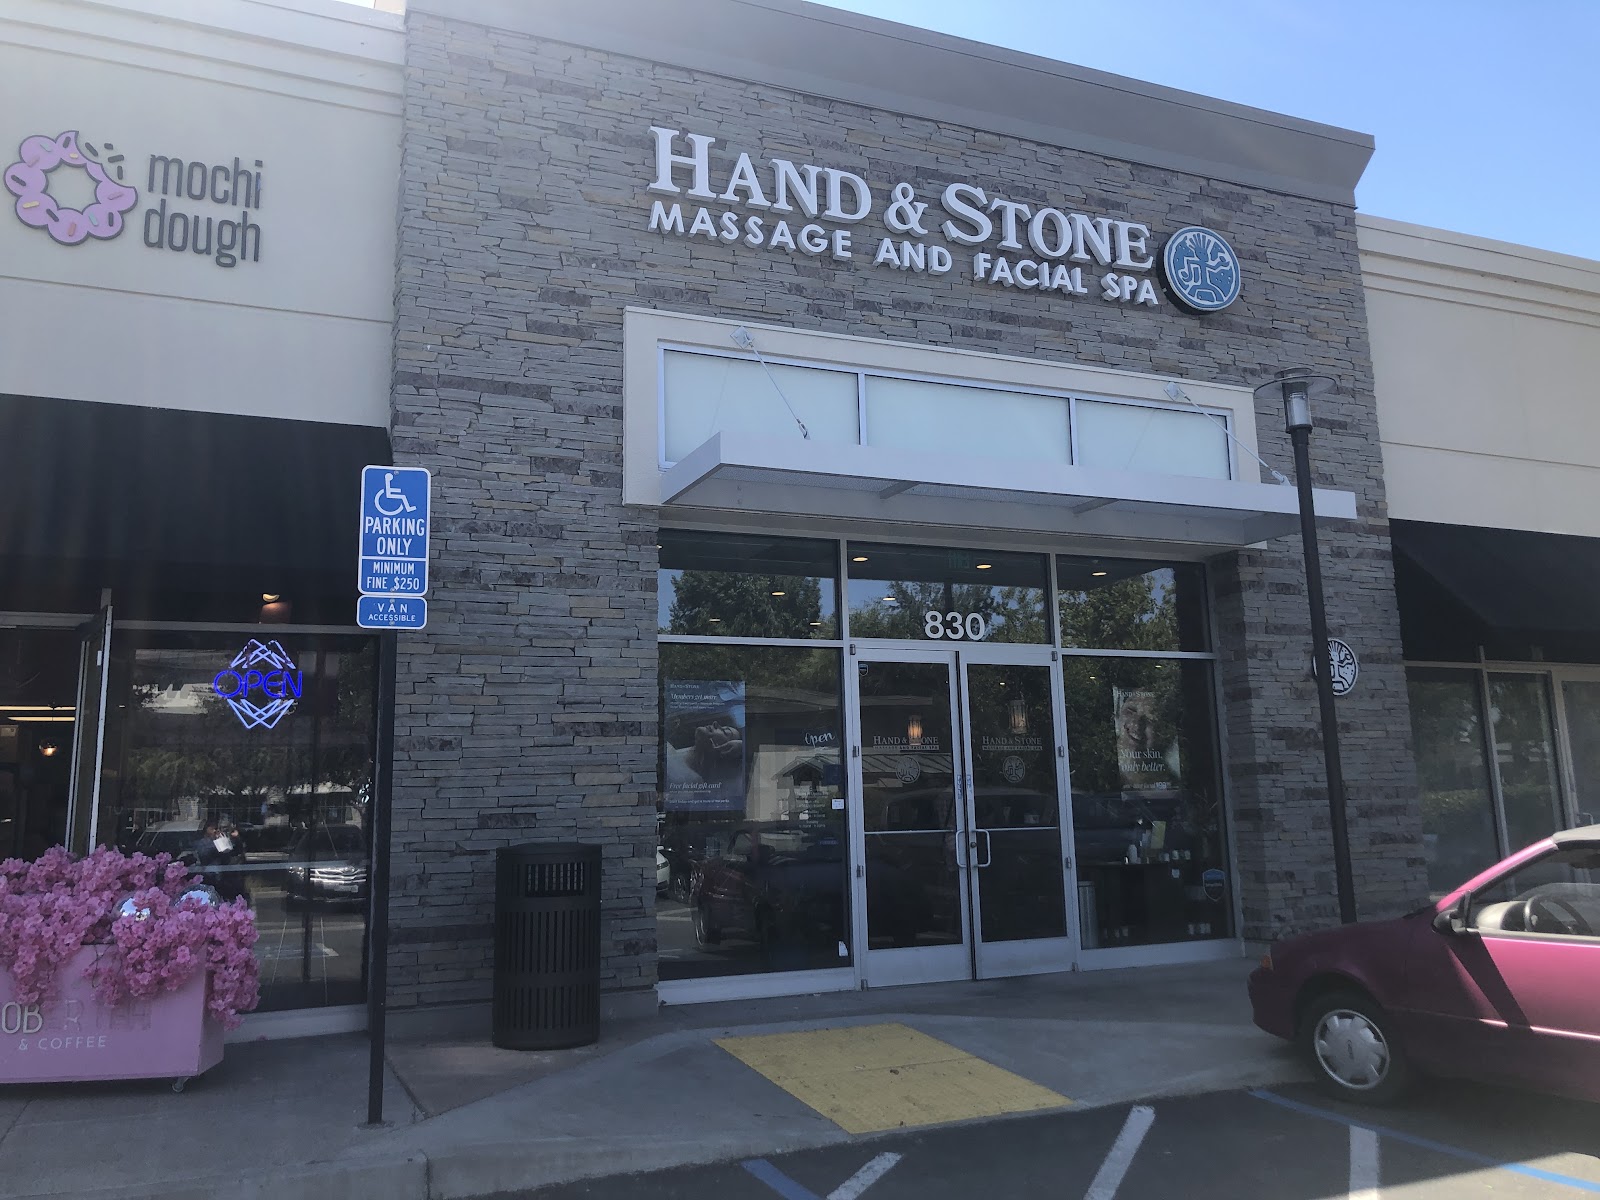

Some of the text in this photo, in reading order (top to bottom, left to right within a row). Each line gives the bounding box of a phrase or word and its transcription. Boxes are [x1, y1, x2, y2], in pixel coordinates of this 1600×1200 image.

[148, 154, 263, 209] mochi
[647, 126, 1154, 272] HAND & STONE
[143, 198, 261, 267] dough
[647, 200, 1159, 305] MASSAGE AND FACIAL SPA
[364, 516, 425, 537] PARKING
[376, 536, 412, 556] ONLY
[372, 561, 415, 575] MINIMUM
[366, 576, 420, 591] FINE $250
[377, 602, 408, 613] VAN
[368, 613, 416, 622] ACCESSIBLE
[924, 610, 985, 640] 830
[213, 669, 303, 699] OPEN
[804, 731, 835, 747] Open
[873, 735, 900, 745] HAND
[982, 735, 1007, 745] HAND
[1014, 735, 1042, 745] STONE
[1120, 748, 1141, 759] Your
[1121, 761, 1166, 774] only better.
[18, 1035, 107, 1050] & COFFEE
